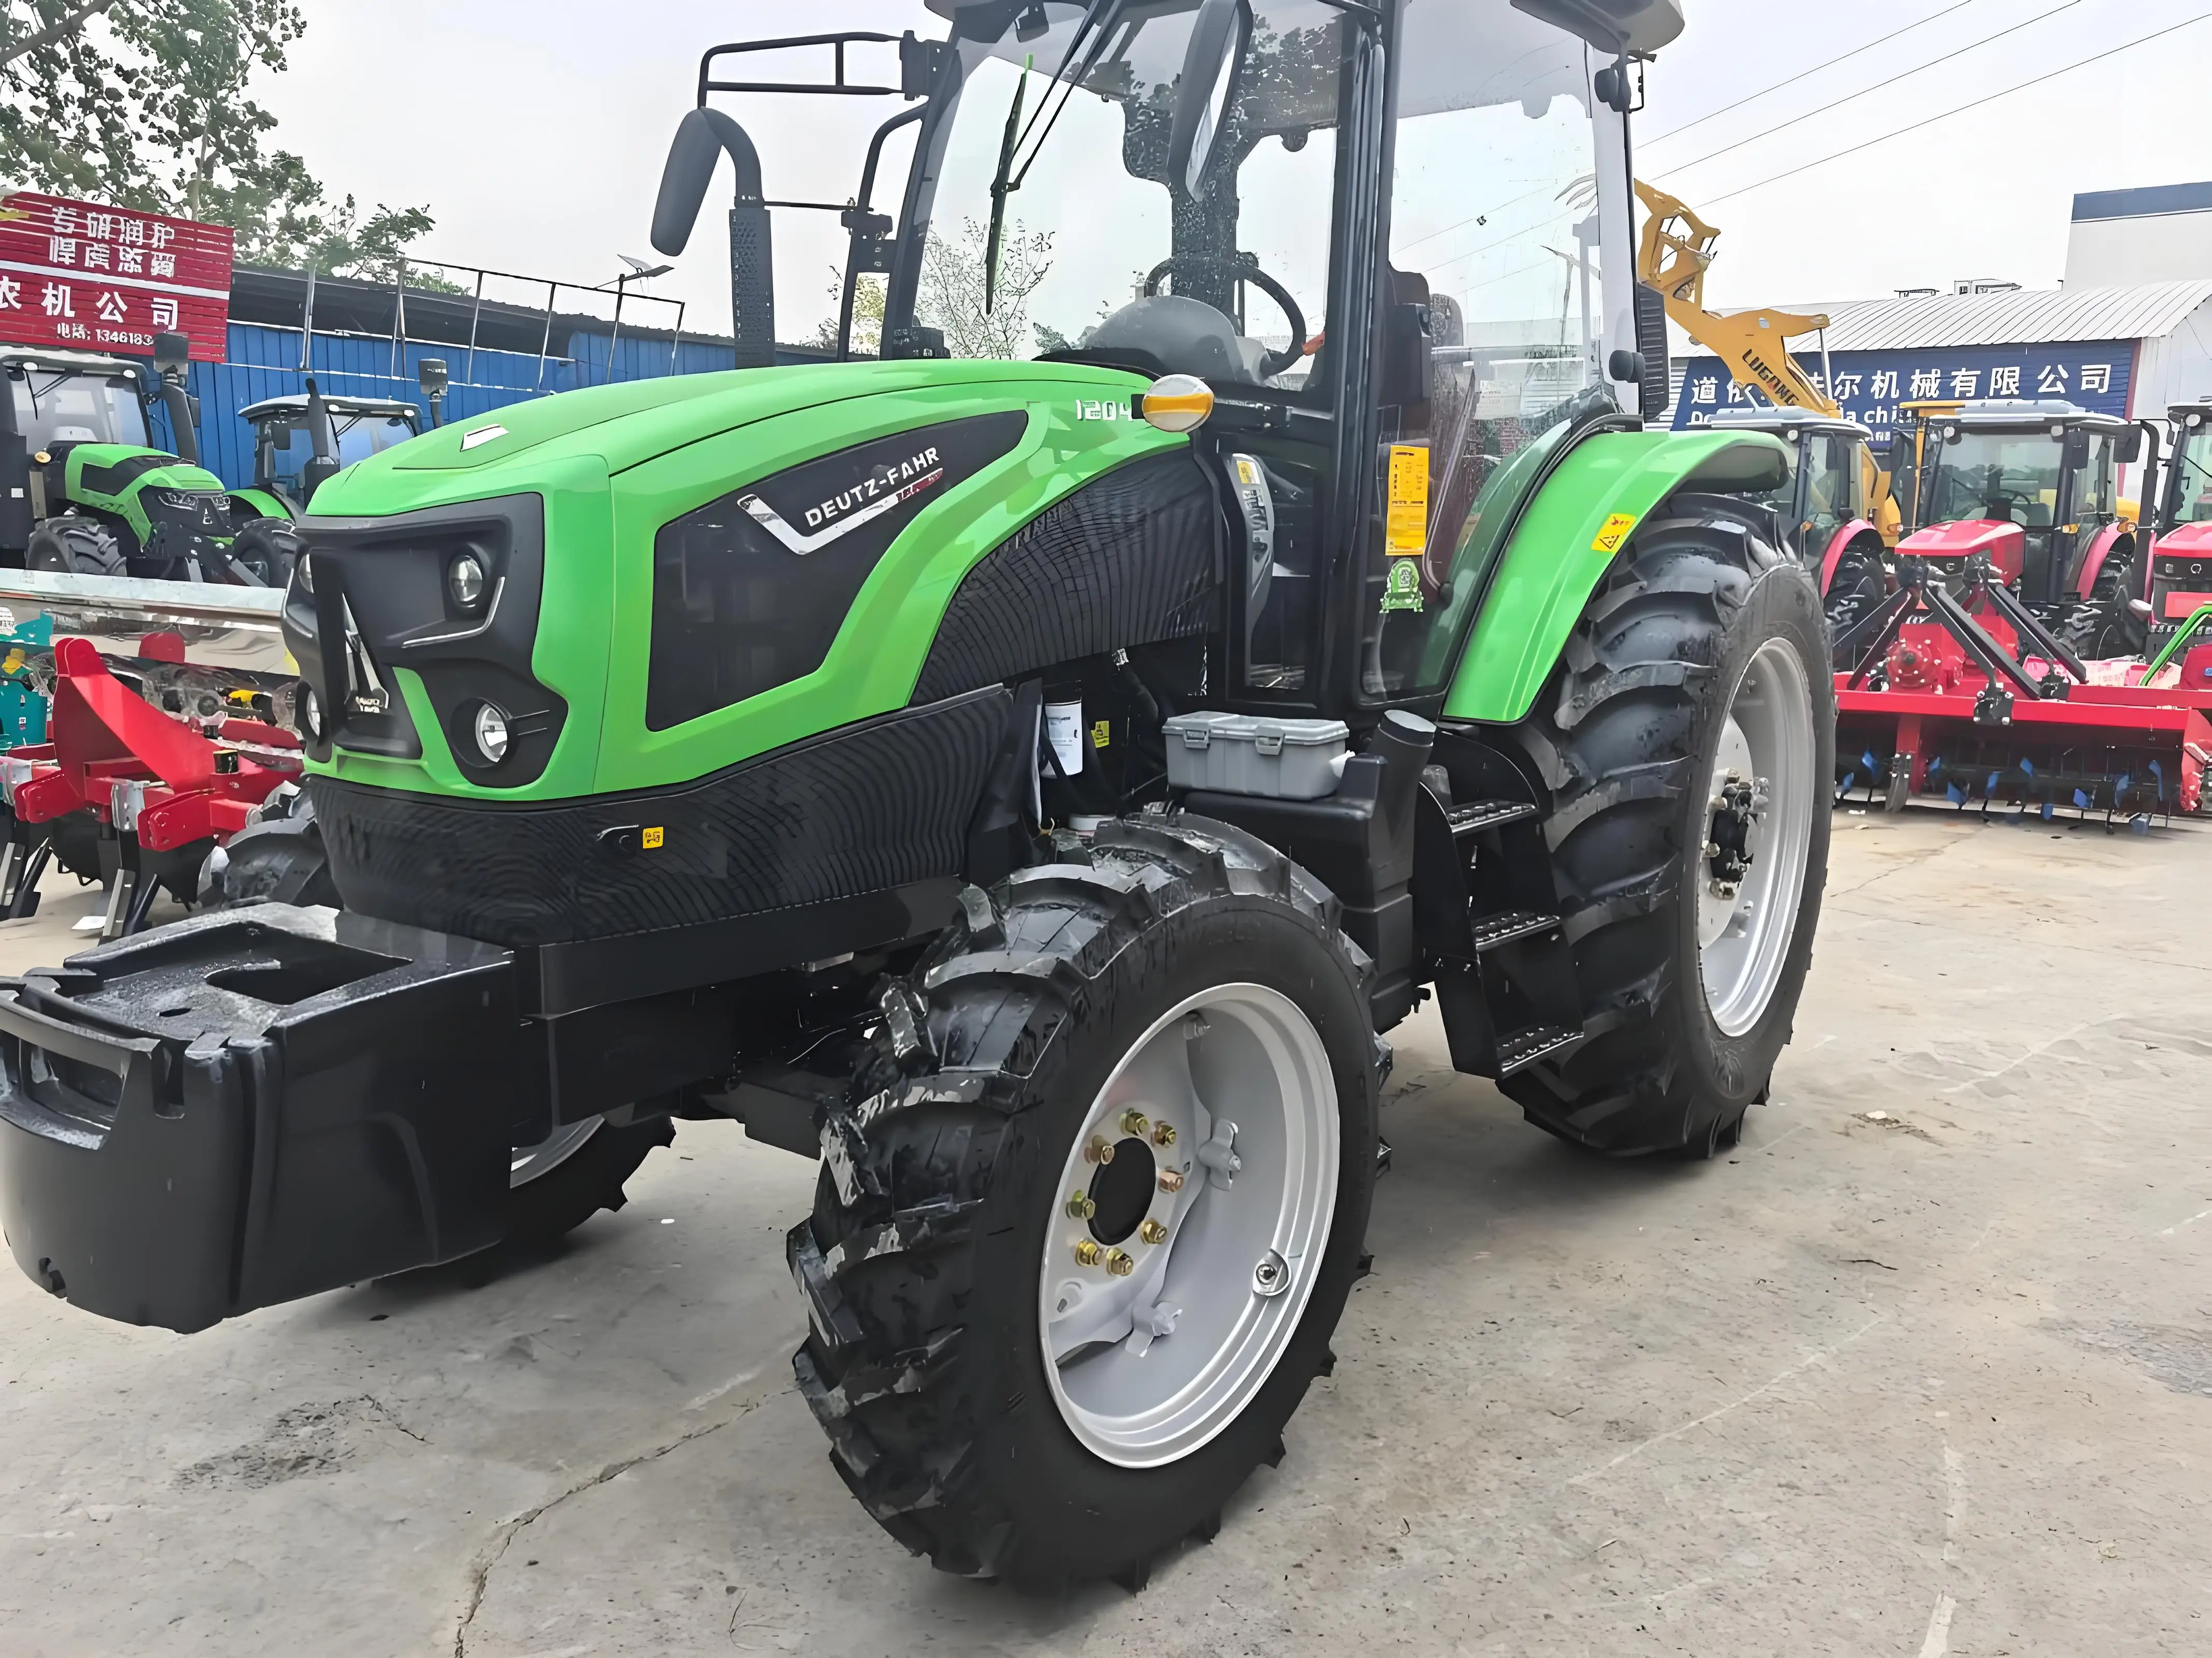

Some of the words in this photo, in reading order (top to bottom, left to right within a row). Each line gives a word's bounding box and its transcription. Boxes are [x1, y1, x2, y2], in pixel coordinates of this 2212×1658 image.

[0, 275, 178, 331] 农机公司
[1076, 399, 1133, 421] 1204
[805, 447, 940, 527] DEUTZ-FAHR
